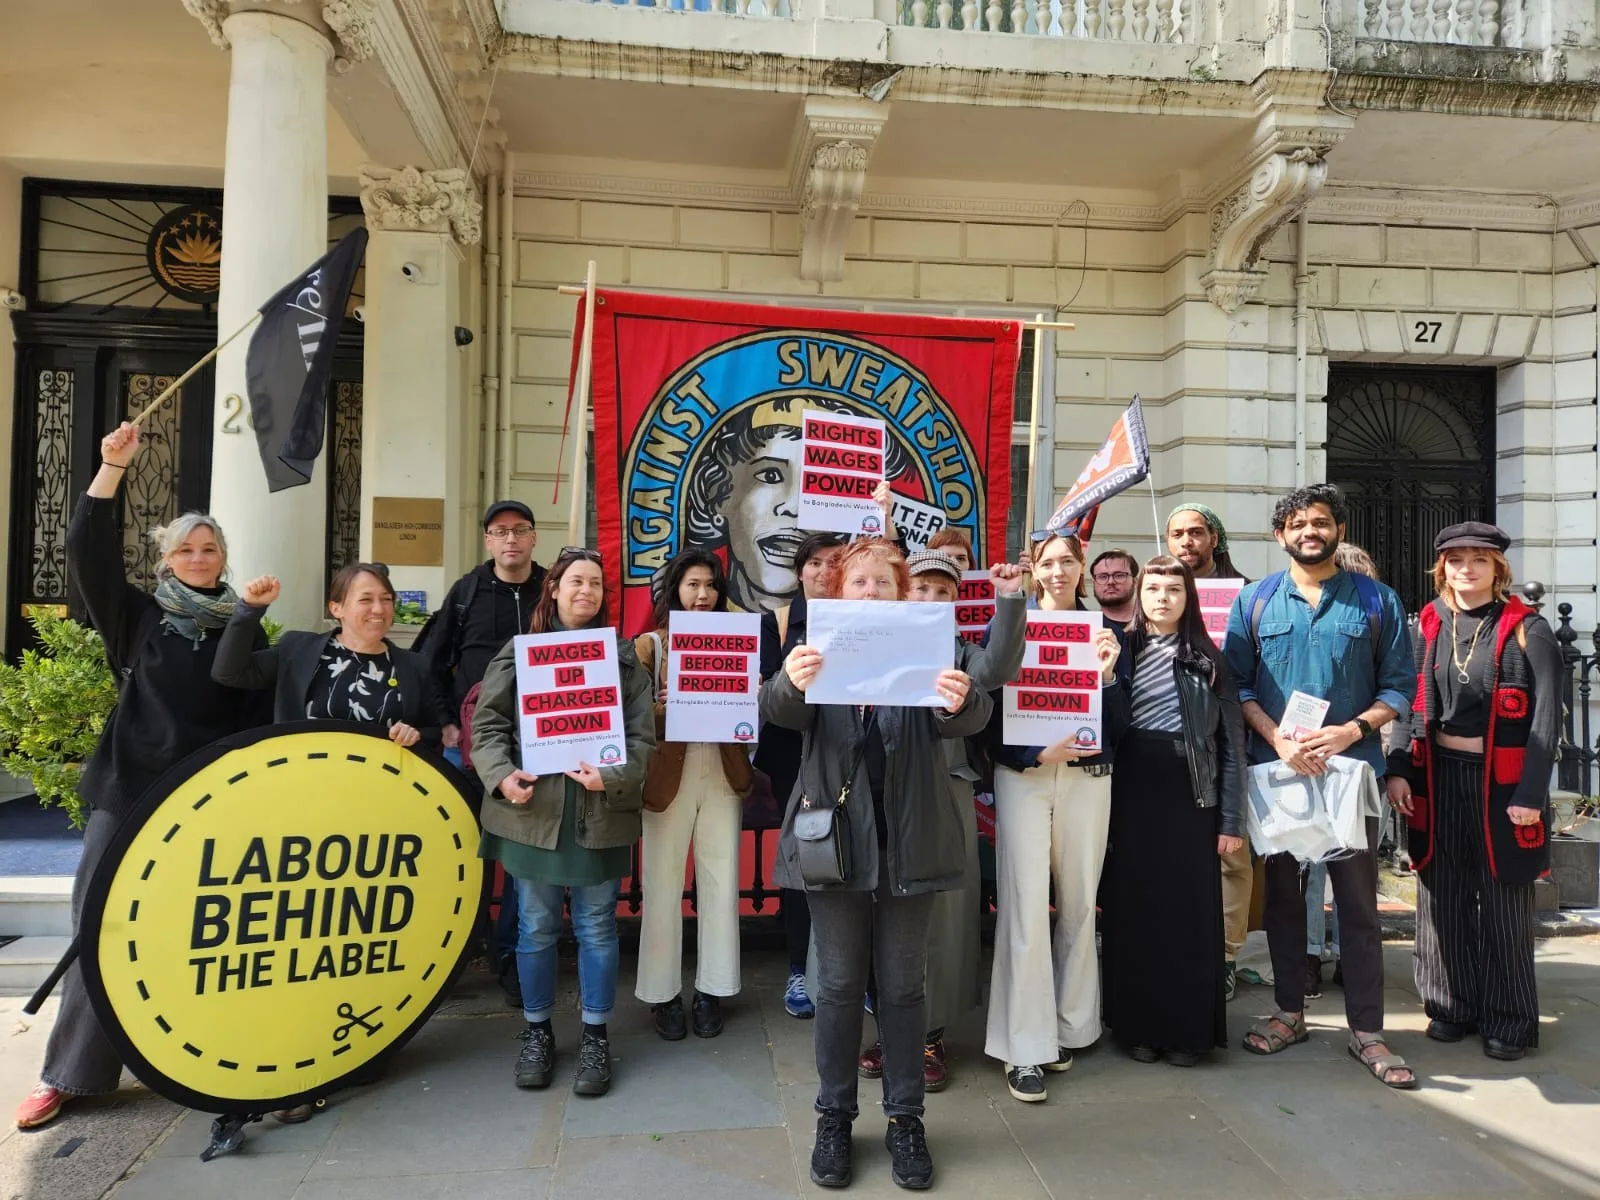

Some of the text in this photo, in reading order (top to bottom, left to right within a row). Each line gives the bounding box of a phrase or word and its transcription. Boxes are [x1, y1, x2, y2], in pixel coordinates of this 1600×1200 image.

[1415, 321, 1442, 343] 27
[807, 422, 878, 446] RIGHTS
[631, 337, 975, 573] AGAINST SWEATSHO
[806, 447, 879, 471] WAGES
[805, 473, 878, 496] POWER
[812, 499, 852, 508] Bangladeshi
[957, 582, 991, 598] HTS
[1199, 591, 1234, 605] HTS
[956, 607, 992, 623] GES
[1025, 623, 1087, 640] WAGES
[674, 636, 755, 651] WORKERS
[531, 643, 601, 663] WAGES
[1043, 648, 1067, 662] UP
[684, 657, 743, 671] BEFORE
[559, 667, 584, 684] UP
[1013, 670, 1096, 687] HARGES
[680, 677, 746, 692] PROFITS
[525, 688, 616, 712] CHARGES
[1021, 693, 1082, 709] DOWN
[540, 714, 603, 734] DOWN
[557, 735, 595, 745] Bangladeshi
[595, 733, 621, 742] Workers
[198, 834, 423, 887] LABOUR
[190, 884, 414, 950] BEHIND
[189, 939, 406, 995] THE LABEL
